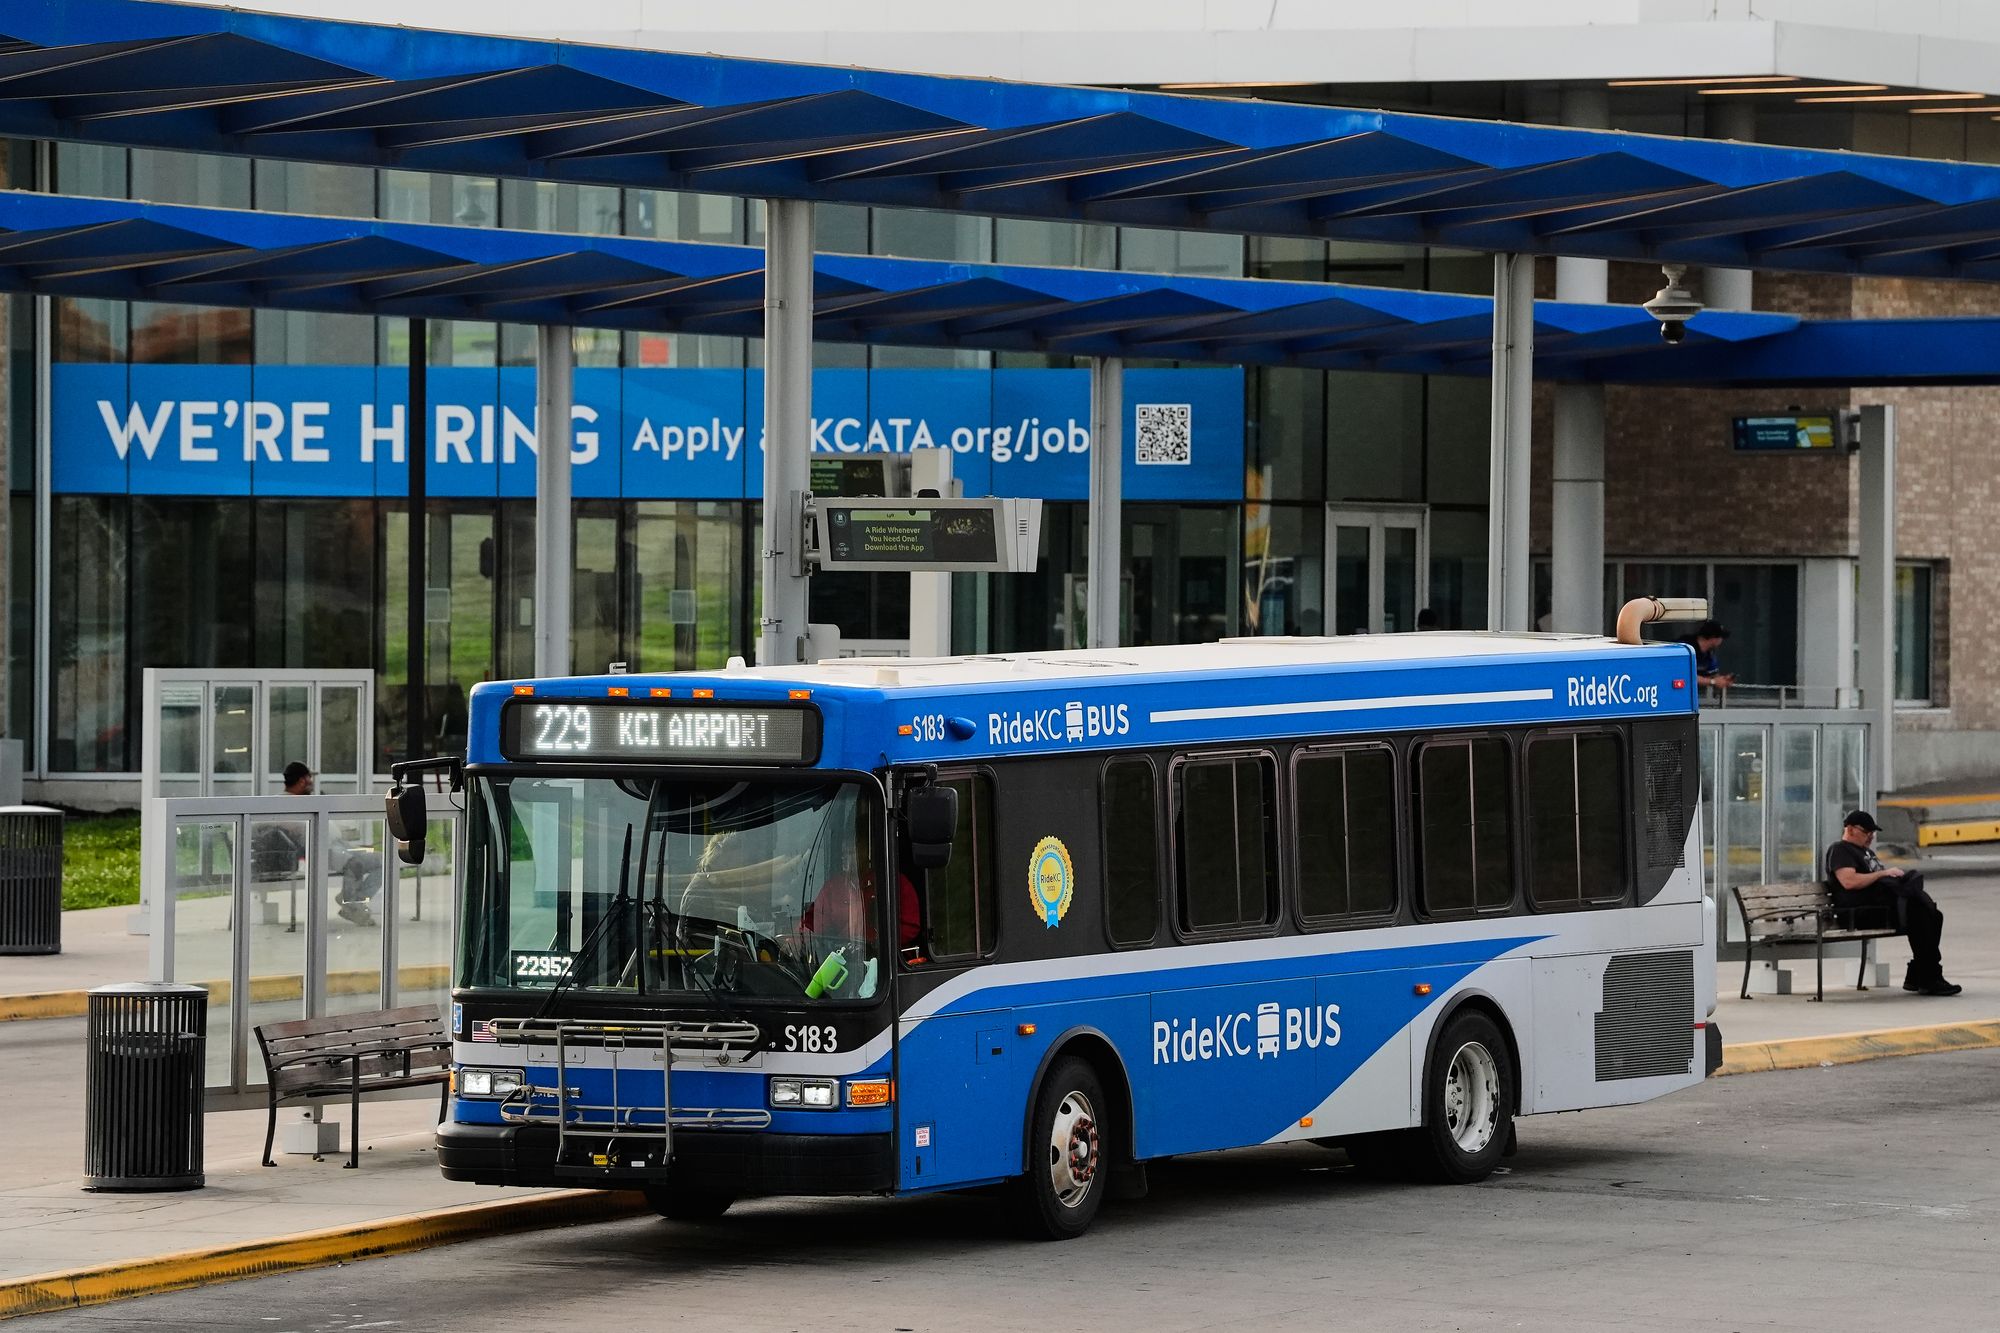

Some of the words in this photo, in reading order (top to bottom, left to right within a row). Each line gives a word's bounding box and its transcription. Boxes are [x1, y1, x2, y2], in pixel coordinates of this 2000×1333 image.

[96, 400, 330, 462] WE'RE
[360, 403, 600, 465] HRING
[632, 417, 745, 461] Apply
[811, 417, 1091, 463] KCATA.org/job
[870, 535, 882, 543] You
[883, 535, 901, 543] Need
[911, 544, 925, 553] App
[1567, 674, 1658, 708] RideKC.org
[535, 706, 592, 750] 229
[618, 712, 660, 746] KCI
[668, 713, 769, 747] AIRPORT
[913, 714, 945, 742] S183
[988, 708, 1063, 745] RideKC
[1087, 703, 1130, 737] BUS
[1040, 872, 1061, 884] RideKC
[516, 955, 573, 977] 22952
[784, 1024, 838, 1053] S183
[1153, 1012, 1251, 1065] RideKC
[1286, 1004, 1341, 1051] BUS
